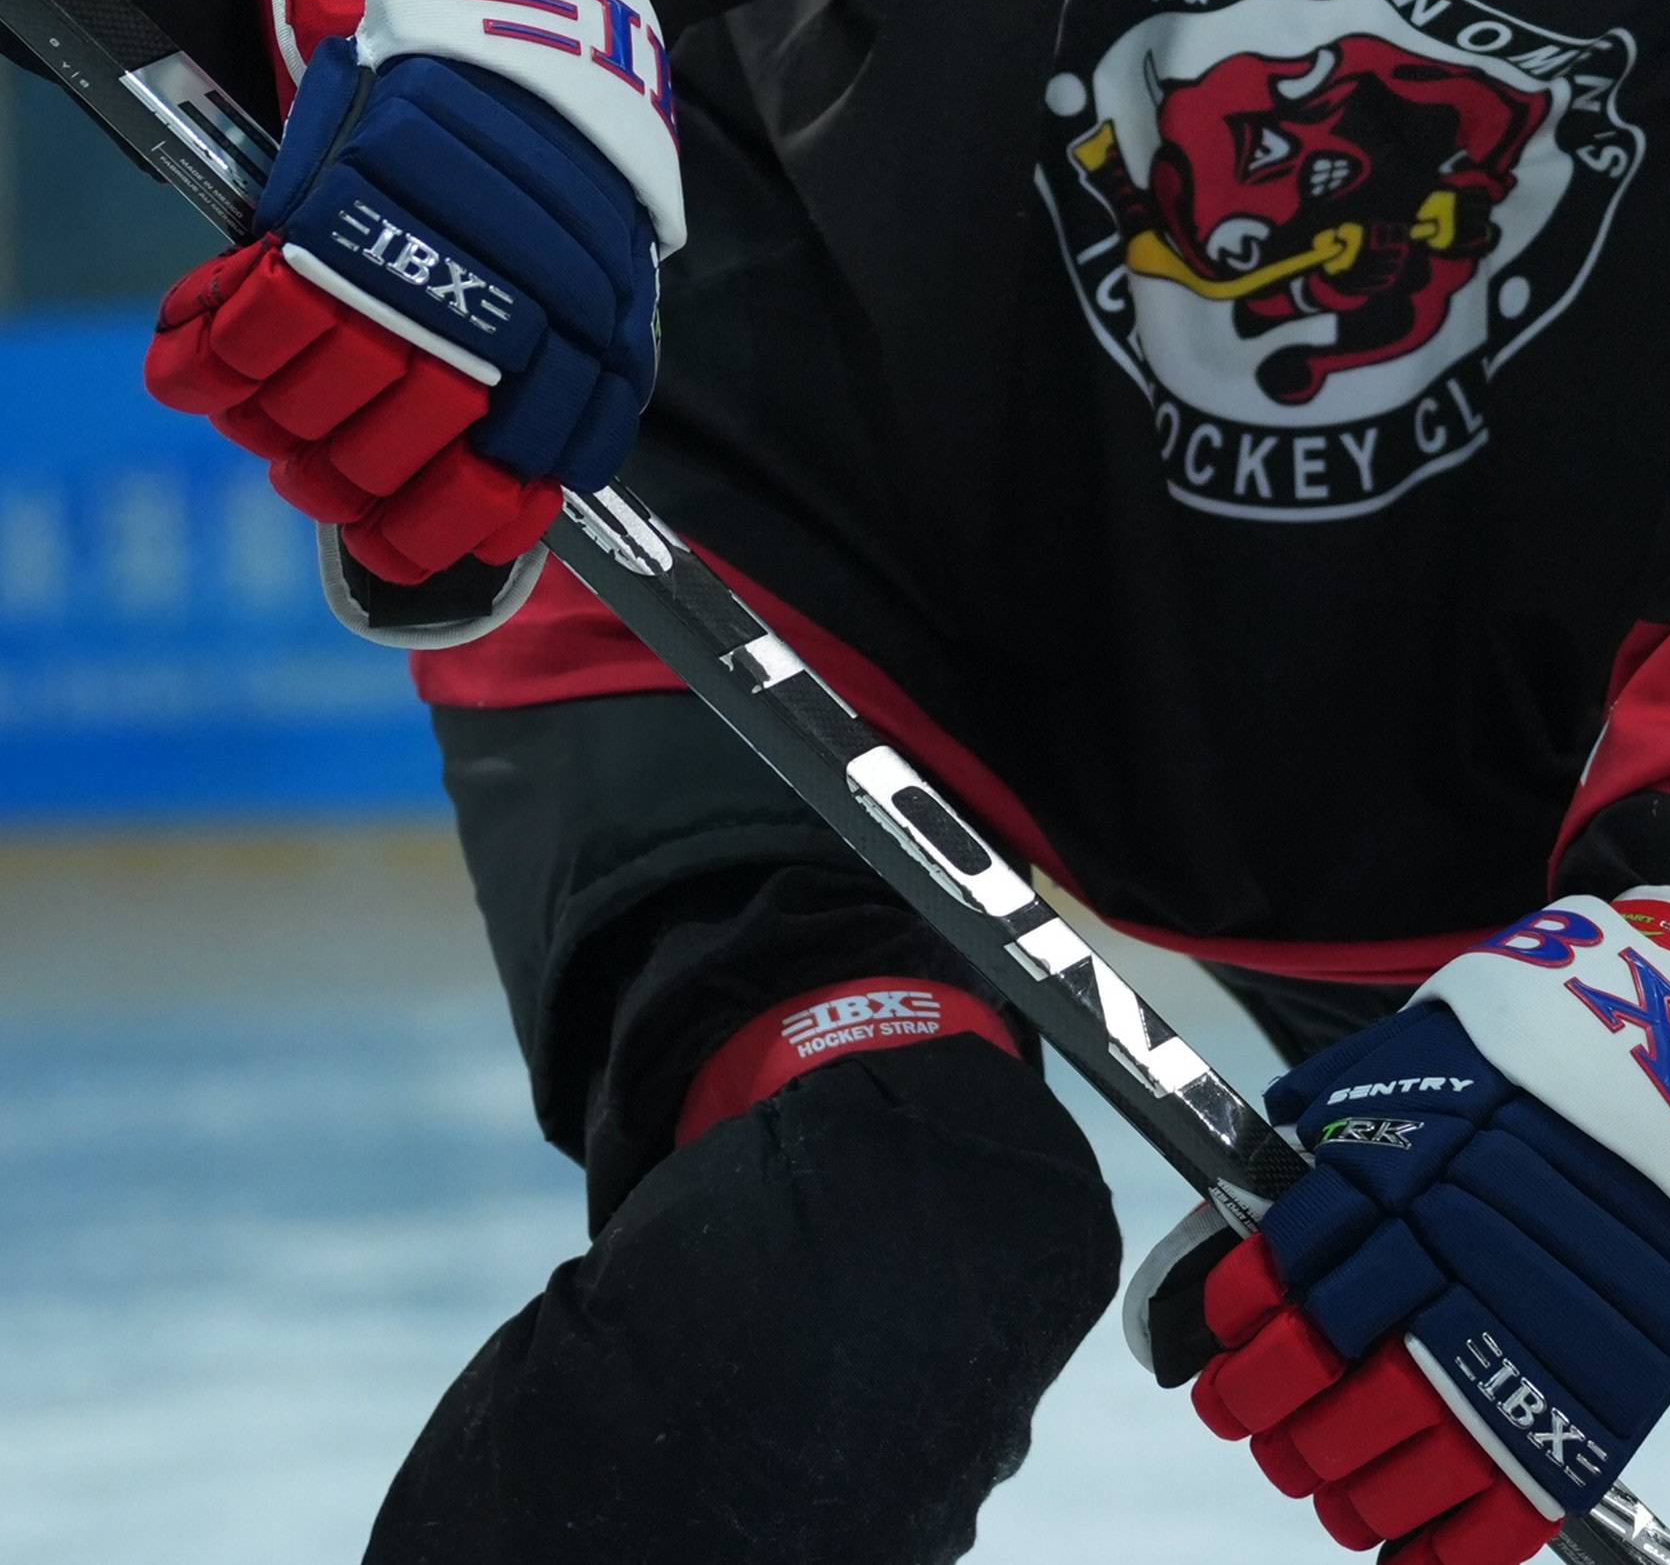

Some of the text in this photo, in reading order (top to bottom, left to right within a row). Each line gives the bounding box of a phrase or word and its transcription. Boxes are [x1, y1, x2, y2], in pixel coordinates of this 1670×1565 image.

[1155, 400, 1379, 502] OCKEY
[797, 1021, 940, 1058] HOCKEY STRAP
[1326, 1076, 1475, 1106] SENTRY
